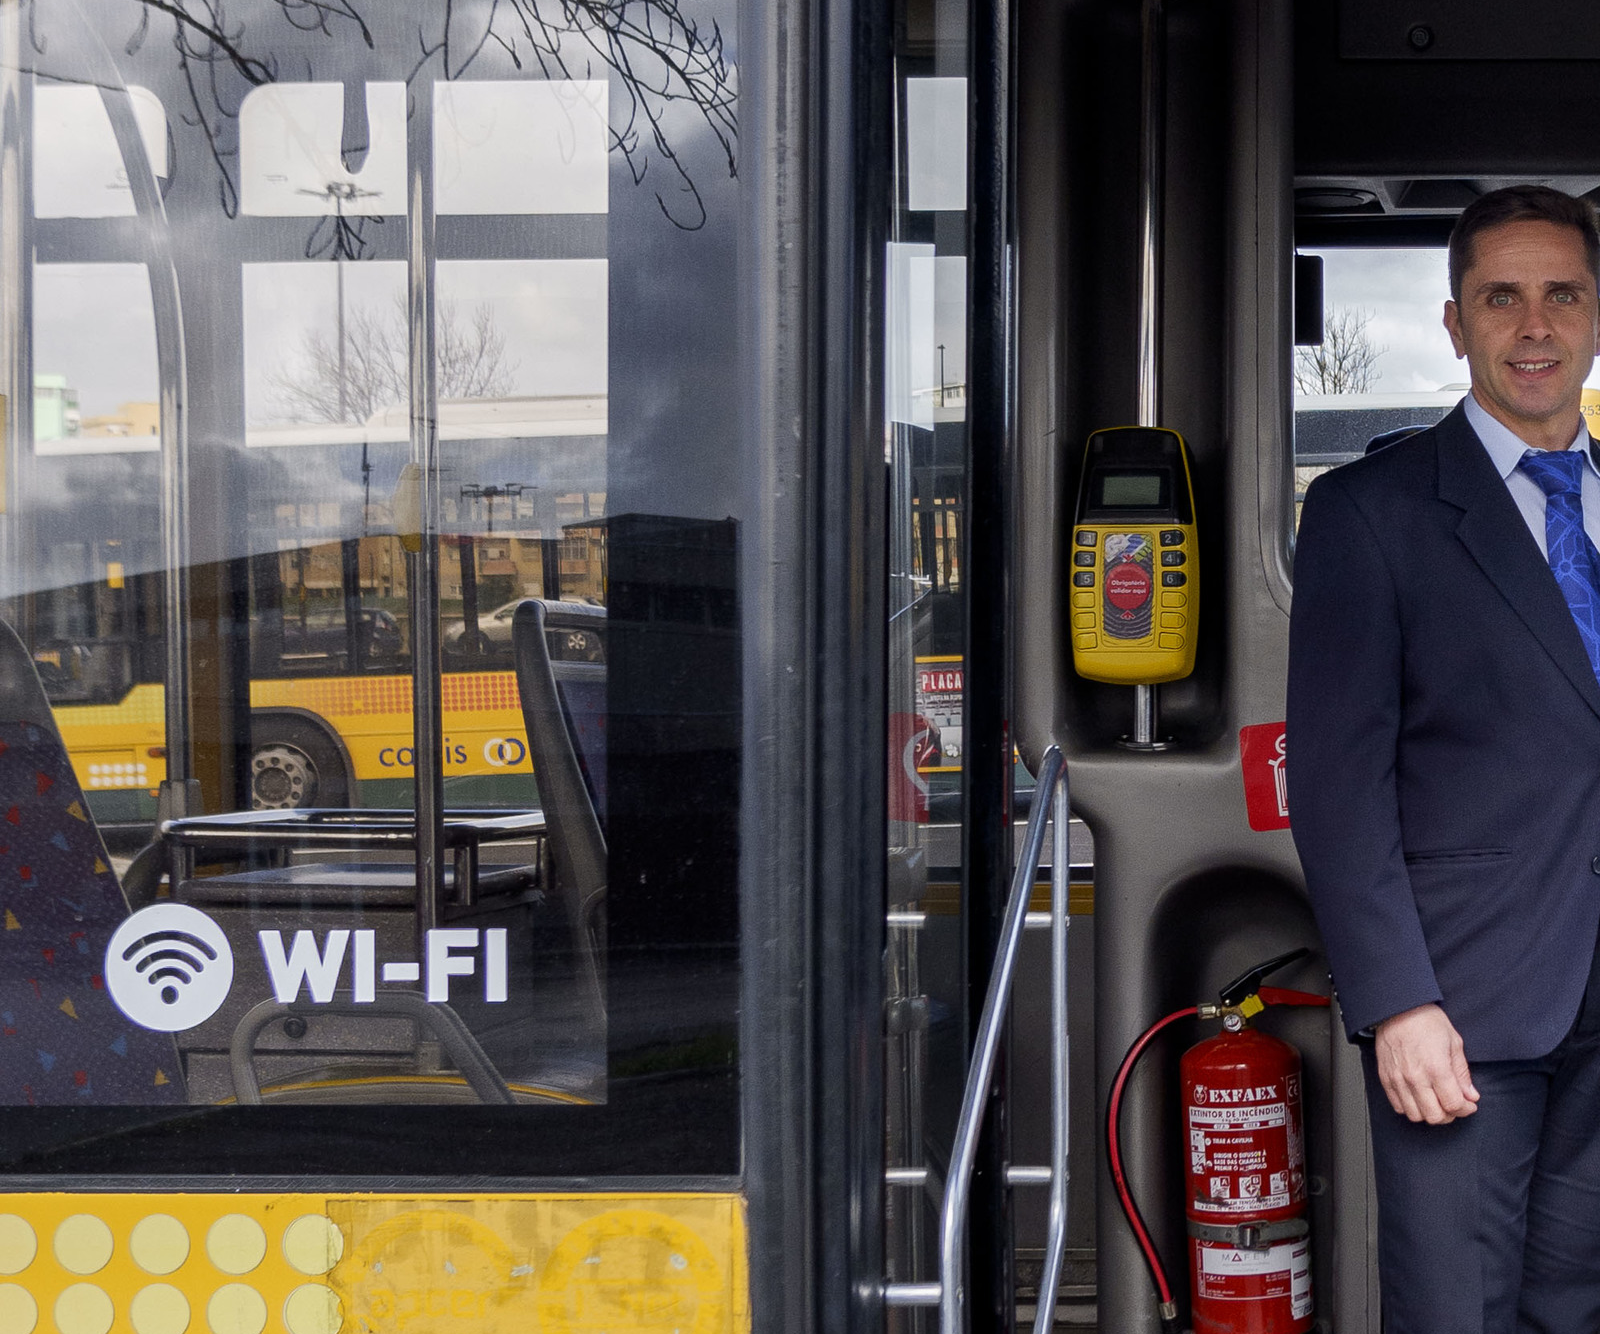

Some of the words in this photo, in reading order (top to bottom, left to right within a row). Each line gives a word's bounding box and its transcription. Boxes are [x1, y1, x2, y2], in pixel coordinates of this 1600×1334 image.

[1164, 534, 1172, 544] 2
[1084, 554, 1091, 564] 3
[1165, 554, 1173, 563] 4
[1083, 574, 1091, 584] 5
[1166, 574, 1174, 584] 6
[379, 738, 468, 767] cais
[258, 927, 508, 1004] WI-FI
[1209, 1085, 1277, 1103] EXFAEX
[1190, 1109, 1223, 1119] EXTINTOR
[1225, 1109, 1236, 1118] DE
[1238, 1105, 1284, 1118] INCÊNDIOS
